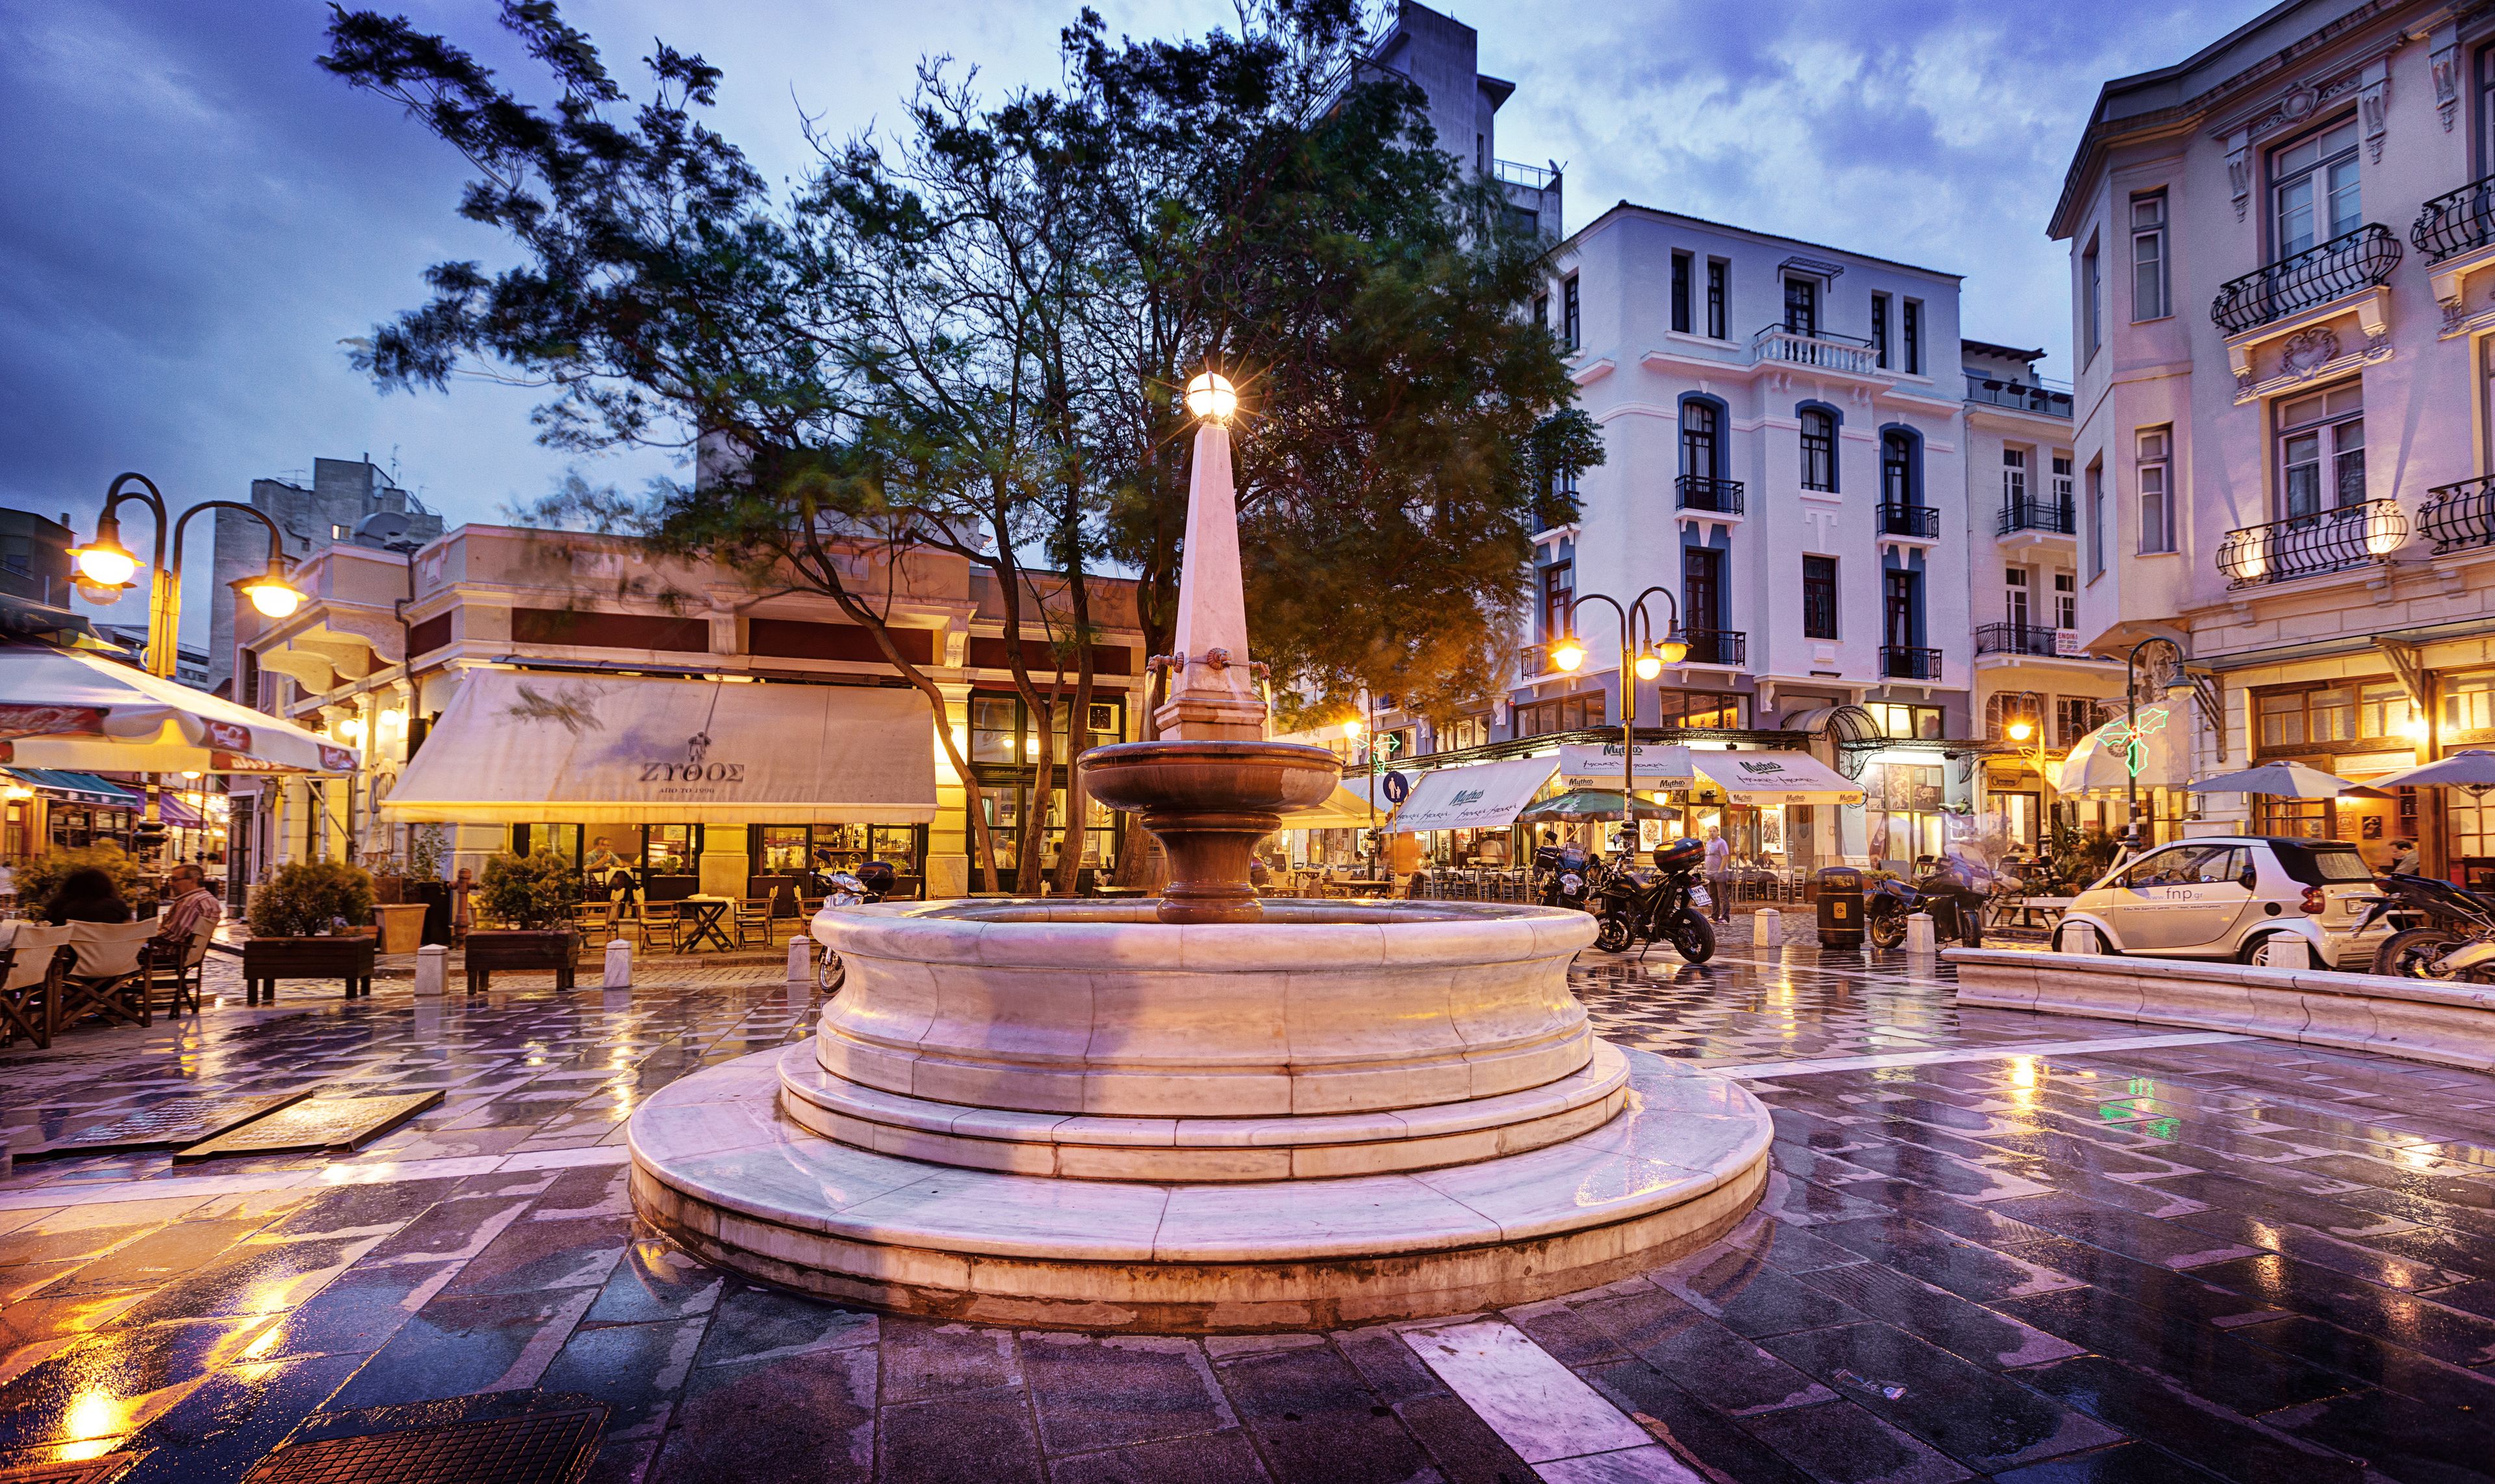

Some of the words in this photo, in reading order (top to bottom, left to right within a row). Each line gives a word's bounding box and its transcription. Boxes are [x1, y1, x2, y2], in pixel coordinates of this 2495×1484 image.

[1603, 745, 1643, 757] Mytos
[638, 762, 745, 782] ΖΥΘΟΣ
[1739, 761, 1785, 774] Mythos
[1568, 778, 1594, 787] Mythos
[1659, 780, 1685, 789] Mythos
[1448, 789, 1485, 806] Mythos
[1733, 794, 1753, 803] Mythos
[1786, 795, 1806, 803] Mythos
[1839, 794, 1858, 803] Mythos
[2145, 887, 2204, 902] www.fnp.gr
